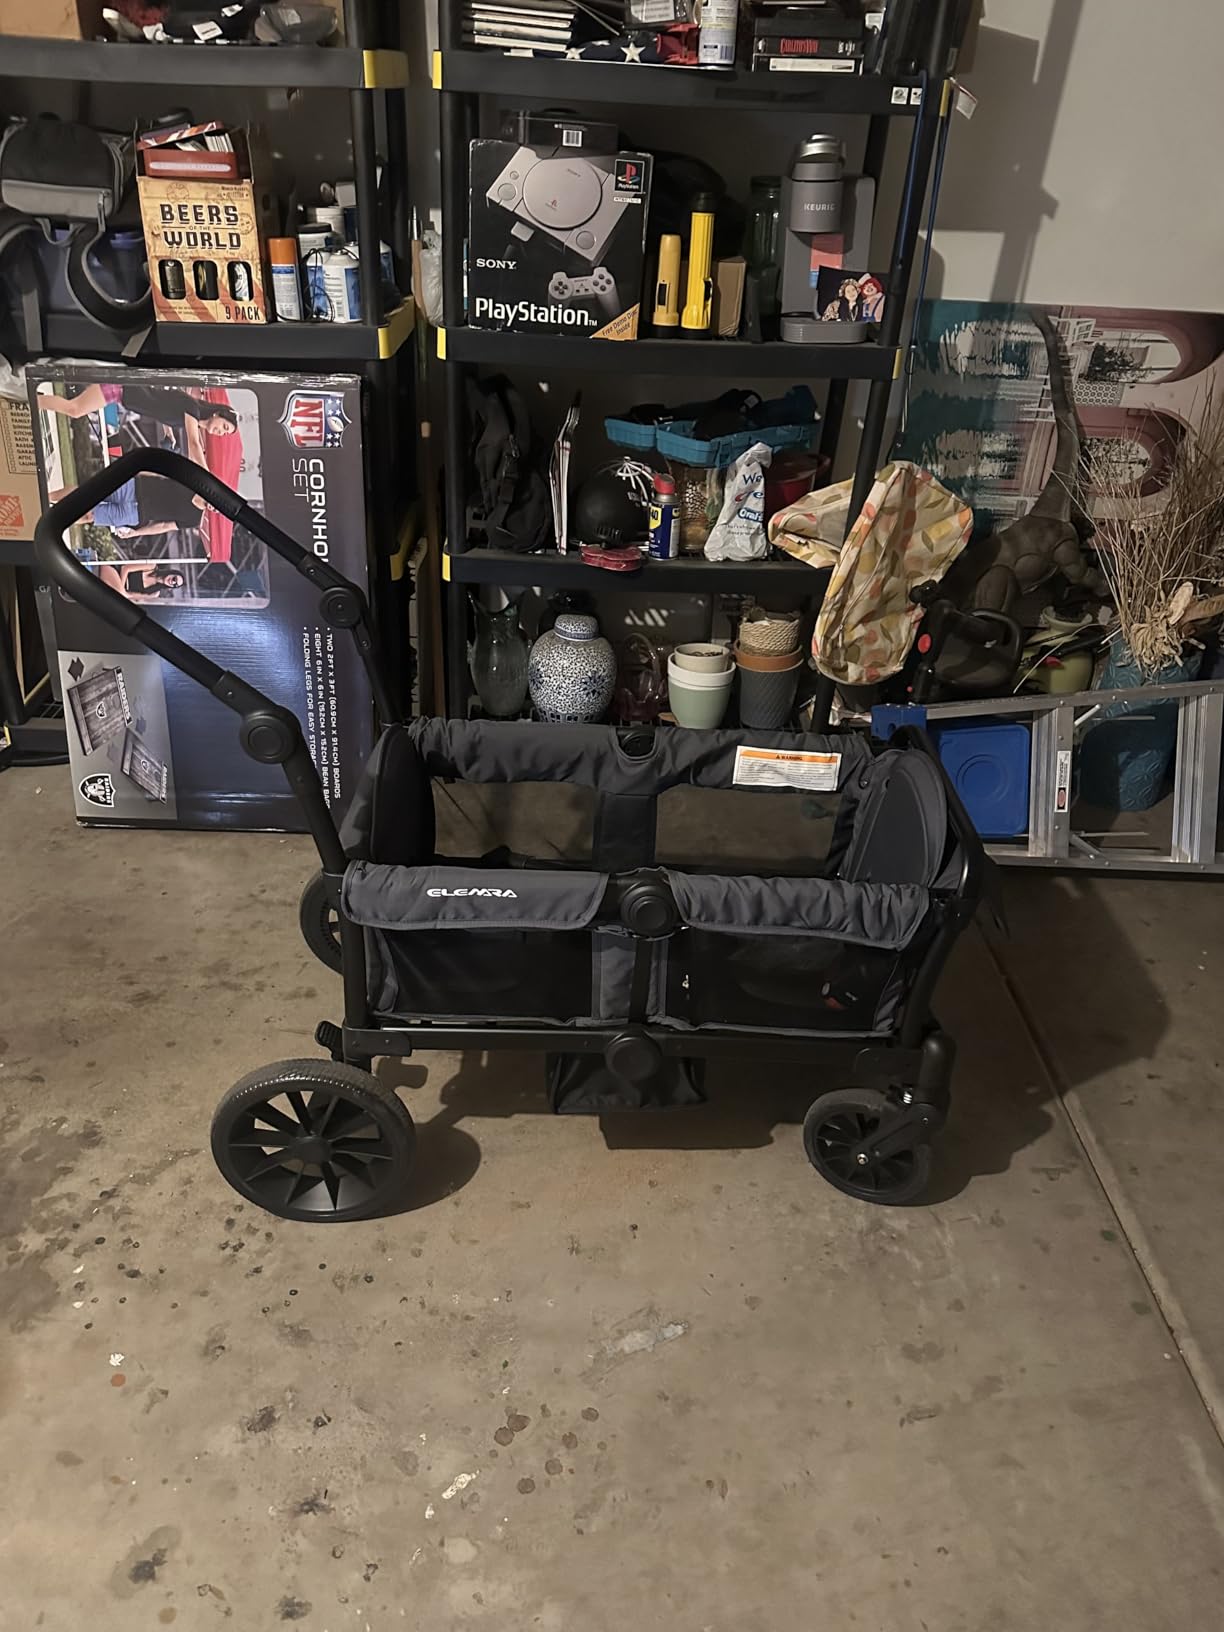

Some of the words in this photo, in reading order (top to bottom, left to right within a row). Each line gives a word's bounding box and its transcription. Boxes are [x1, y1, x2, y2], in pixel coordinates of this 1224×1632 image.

[160, 203, 240, 225] BEERS
[163, 231, 241, 250] WORLD
[476, 258, 517, 270] SONY
[225, 306, 231, 320] 9
[235, 306, 260, 320] PACK
[475, 297, 589, 327] PlayStation
[602, 325, 613, 337] Free
[613, 316, 627, 329] Demo
[290, 398, 324, 448] NFL
[292, 458, 310, 503] SET
[303, 632, 311, 668] FOLDING
[305, 670, 313, 691] LEGS
[116, 672, 131, 720] RAIDERS
[306, 693, 314, 710] FOR
[307, 711, 315, 732] EASY
[326, 633, 334, 651] TWO
[333, 767, 341, 799] BOARDS
[321, 767, 329, 787] BEAN
[104, 777, 112, 804] RAIDERS
